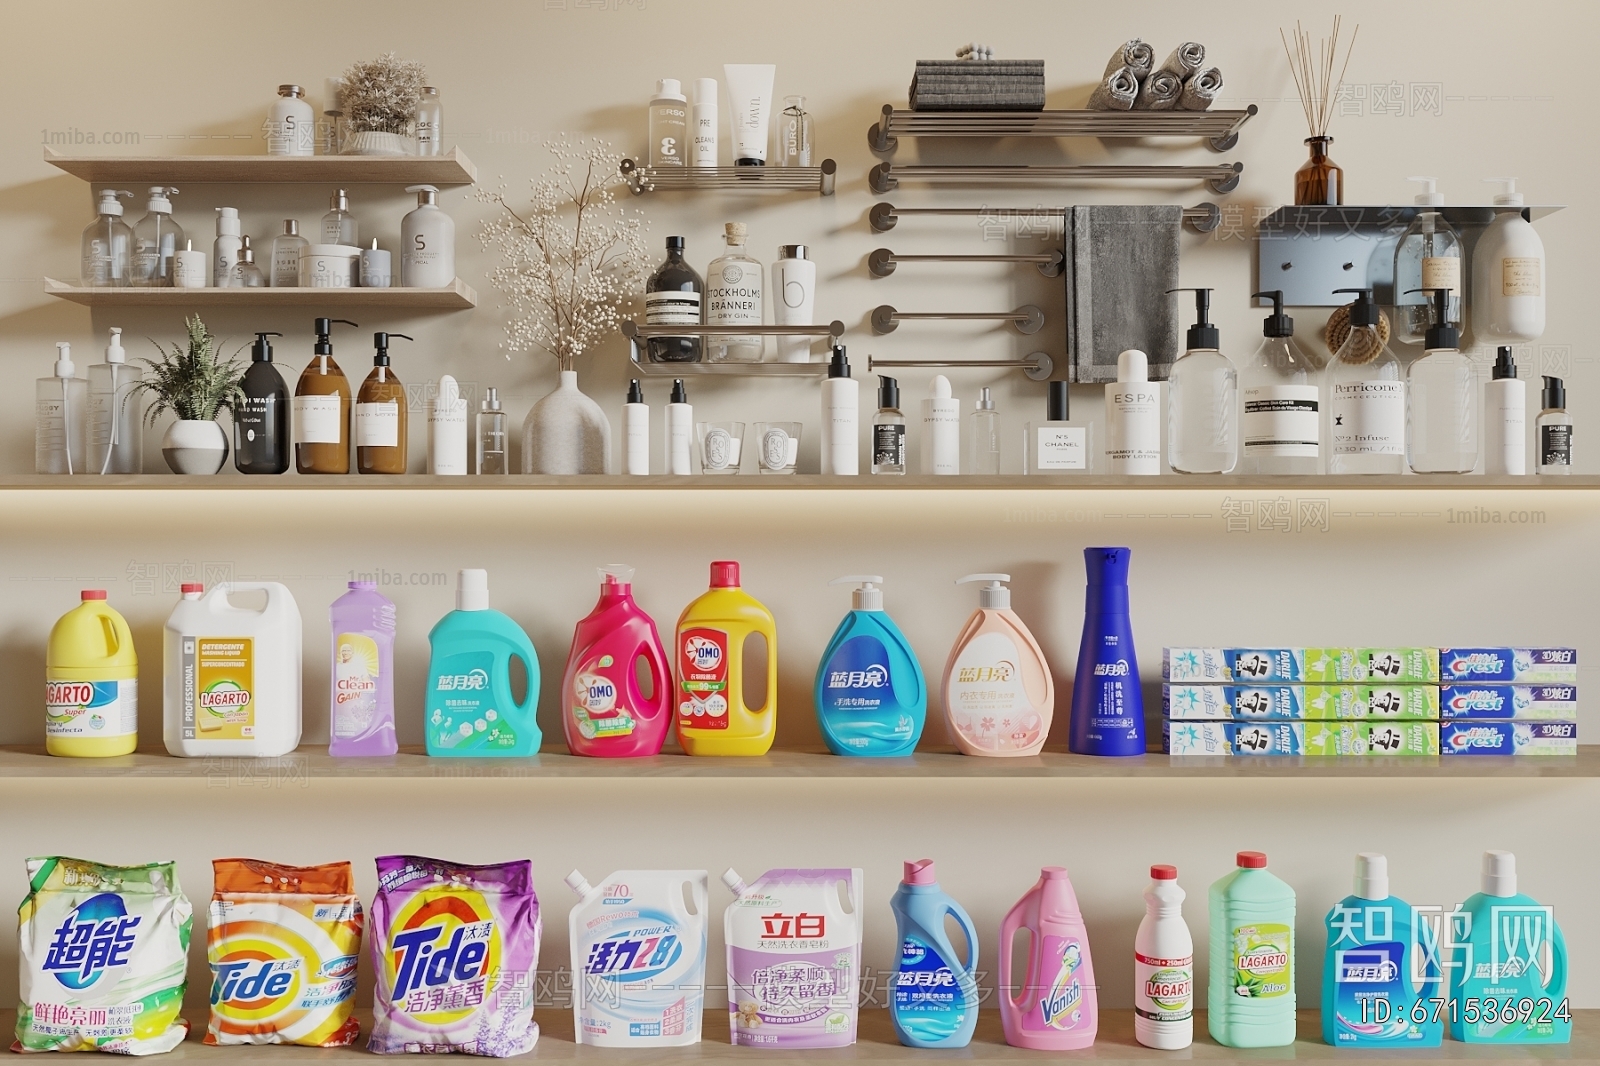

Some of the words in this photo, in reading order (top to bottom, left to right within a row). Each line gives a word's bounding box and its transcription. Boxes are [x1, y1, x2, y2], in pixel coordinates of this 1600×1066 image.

[285, 115, 295, 130] S
[700, 119, 711, 127] PRE
[414, 234, 426, 250] S
[176, 257, 183, 268] S
[219, 256, 228, 268] S
[317, 260, 326, 272] S
[363, 256, 370, 267] S
[237, 266, 243, 275] S
[707, 287, 761, 299] STOCKHOLMS
[1335, 382, 1398, 393] Perricone
[1114, 393, 1156, 404] ESPA
[201, 643, 245, 651] DETERGENTE
[698, 647, 720, 658] OMO
[957, 660, 1015, 683] 蓝月亮
[1093, 659, 1130, 676] 蓝月亮
[1280, 651, 1291, 680] DARLIE
[1413, 651, 1422, 679] DARLIE
[1452, 657, 1504, 674] Crest
[337, 679, 375, 690] Clean
[436, 669, 489, 691] 蓝月亮
[827, 664, 889, 689] 蓝月亮
[46, 685, 91, 704] GARTO
[185, 663, 194, 723] PROFESSIONAL
[202, 691, 249, 706] LAGARTO
[337, 691, 361, 704] GAIN
[589, 685, 613, 698] OMO
[1280, 688, 1291, 717] DARLIE
[1413, 688, 1422, 716] DARLIE
[1452, 694, 1504, 711] Crest
[64, 707, 87, 717] Super
[1280, 725, 1291, 754] DARLIE
[1413, 725, 1422, 753] DARLIE
[1452, 731, 1504, 748] Crest
[613, 884, 629, 897] 70
[463, 922, 493, 941] 汰渍
[633, 925, 672, 937] POWER
[761, 912, 825, 938] 立白
[42, 914, 142, 980] 超能
[757, 940, 829, 949] 天然洗衣香皂粉
[585, 934, 678, 975] 活力28
[1239, 952, 1287, 969] LAGARTO
[391, 926, 487, 1001] Tide
[209, 962, 293, 1005] Tide
[751, 967, 824, 985] 倍净柔顺
[896, 966, 957, 987] 蓝月亮
[762, 982, 835, 1001] 持久留香
[1261, 983, 1287, 994] Aloe
[1040, 979, 1081, 1025] Vanish
[34, 1002, 107, 1025] 鲜艳亮丽
